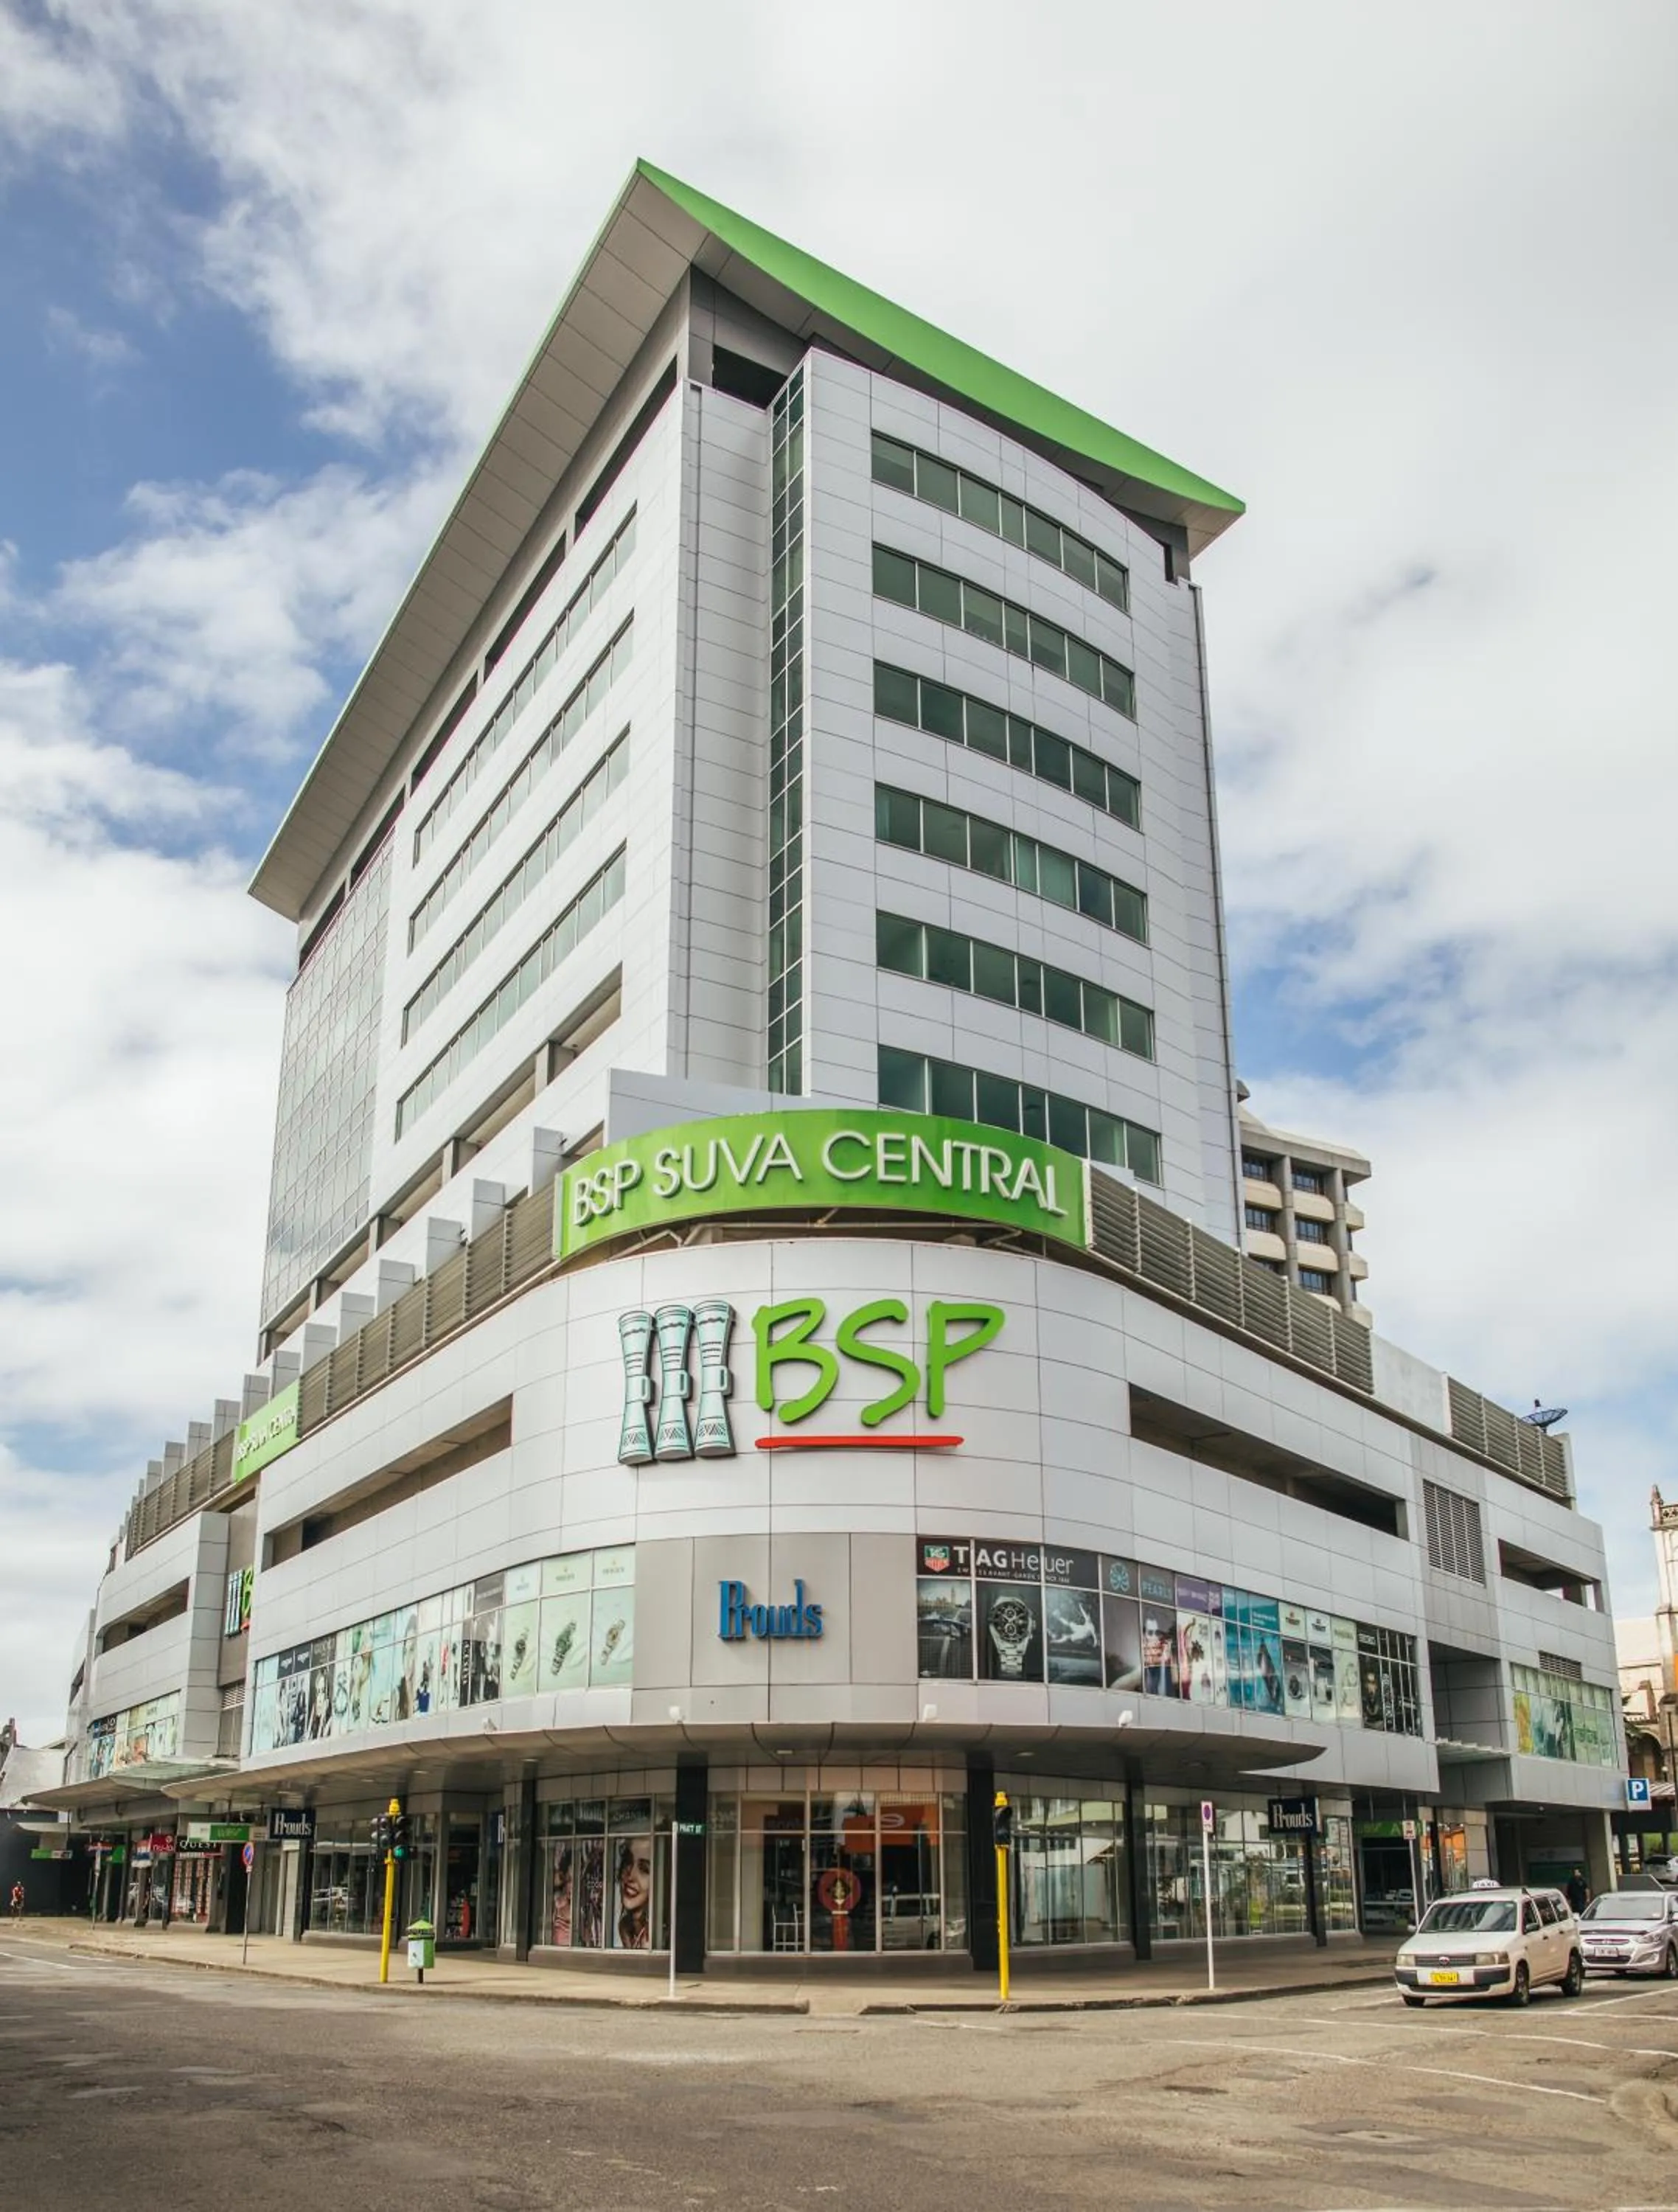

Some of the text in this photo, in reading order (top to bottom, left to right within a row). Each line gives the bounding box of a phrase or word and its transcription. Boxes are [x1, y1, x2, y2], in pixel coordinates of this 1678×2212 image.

[572, 1130, 1068, 1227] BSP SUVA CENTRAL
[752, 1298, 1006, 1427] BSP
[953, 1546, 1007, 1568] TAG
[1012, 1551, 1074, 1575] Heuer
[718, 1579, 824, 1640] Prouds
[1632, 1781, 1644, 1799] P
[274, 1813, 312, 1835] Prouds
[1272, 1803, 1314, 1829] Prouds
